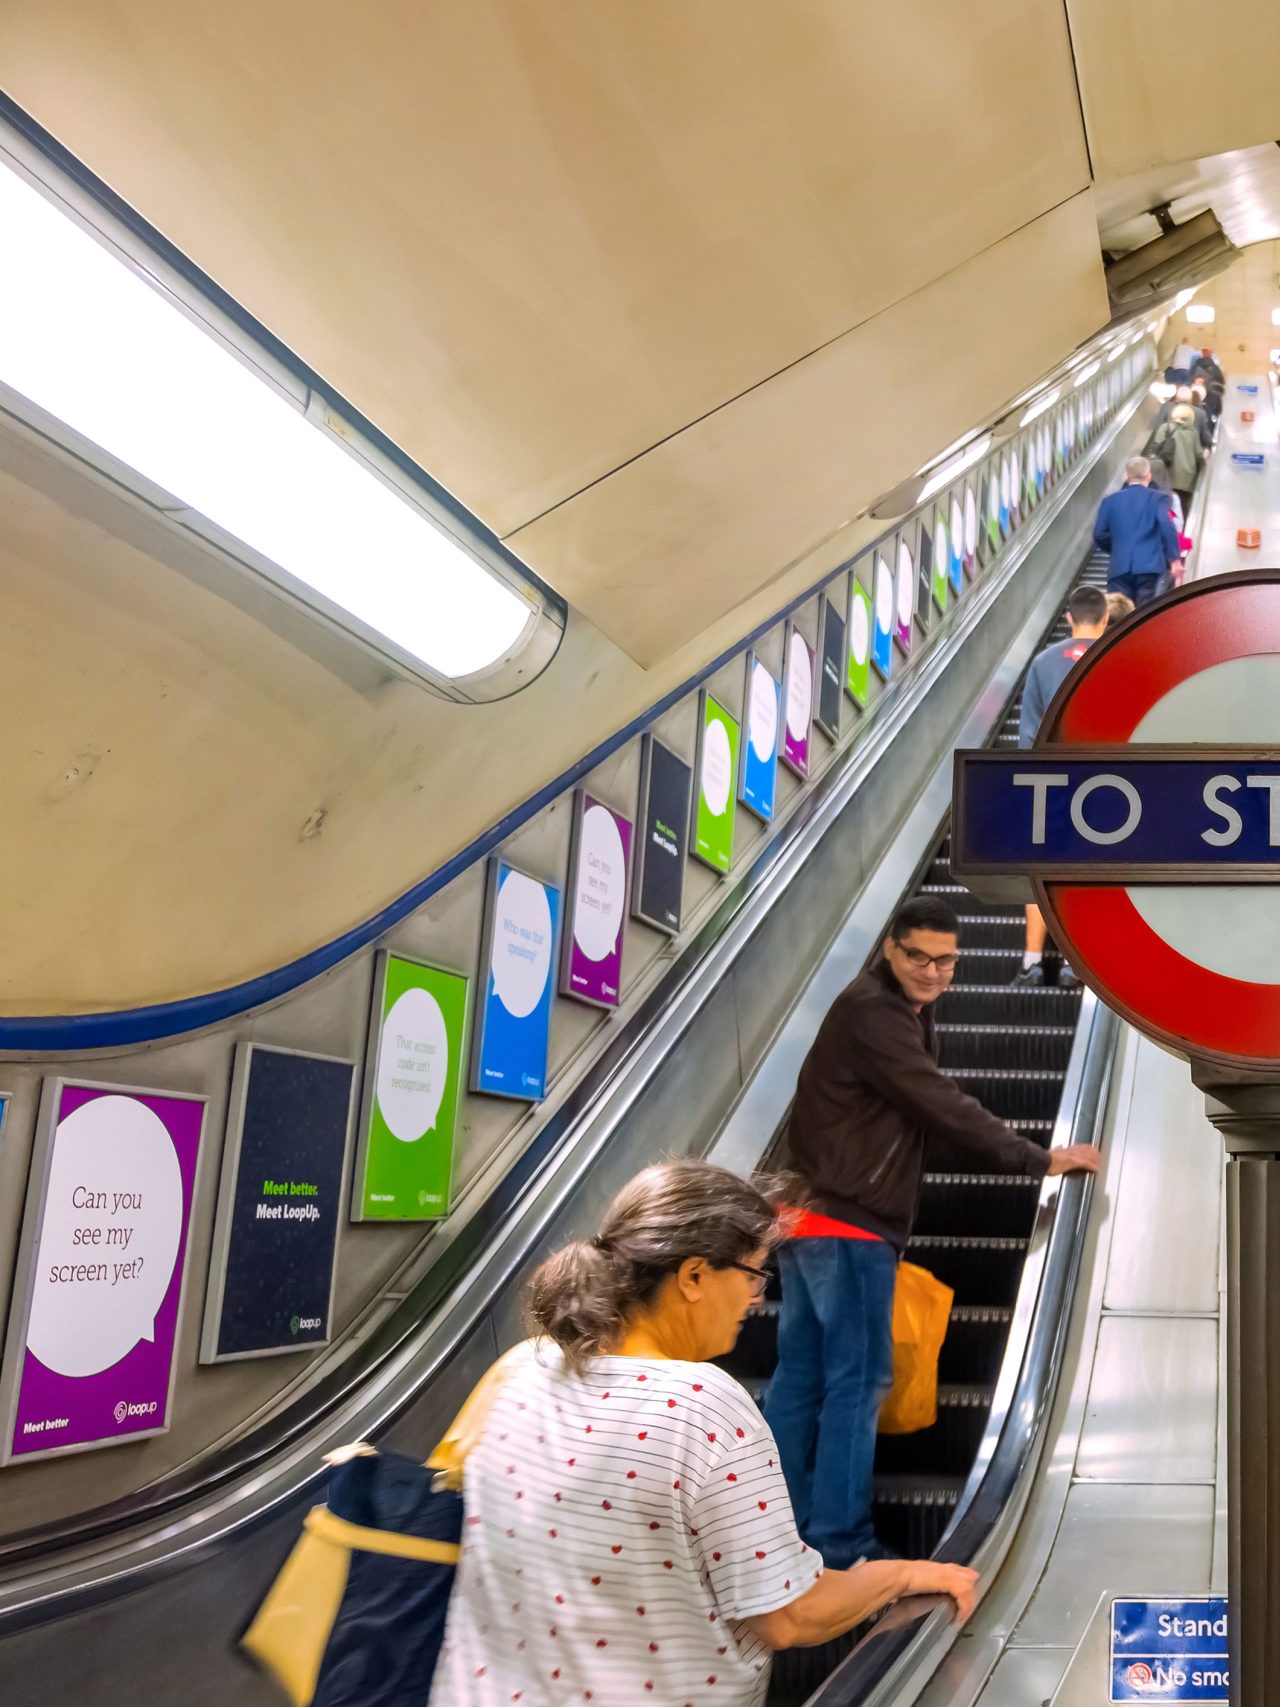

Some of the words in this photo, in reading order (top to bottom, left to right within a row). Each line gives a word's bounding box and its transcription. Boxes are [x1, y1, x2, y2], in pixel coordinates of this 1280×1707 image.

[1013, 773, 1142, 845] TO
[396, 1034, 413, 1050] That
[263, 1181, 288, 1195] Meet
[290, 1181, 318, 1196] better.
[72, 1186, 107, 1209] Can
[111, 1192, 143, 1215] you
[256, 1204, 282, 1219] Meet
[283, 1204, 320, 1222] LoopUp.
[72, 1228, 102, 1245] see
[105, 1228, 133, 1250] my
[49, 1263, 108, 1283] screen
[111, 1257, 144, 1286] yet?
[300, 1317, 322, 1330] loopup
[127, 1401, 158, 1417] loopup
[23, 1422, 44, 1434] Meet
[45, 1418, 70, 1430] better
[1158, 1614, 1228, 1637] Stand
[1156, 1667, 1187, 1687] No
